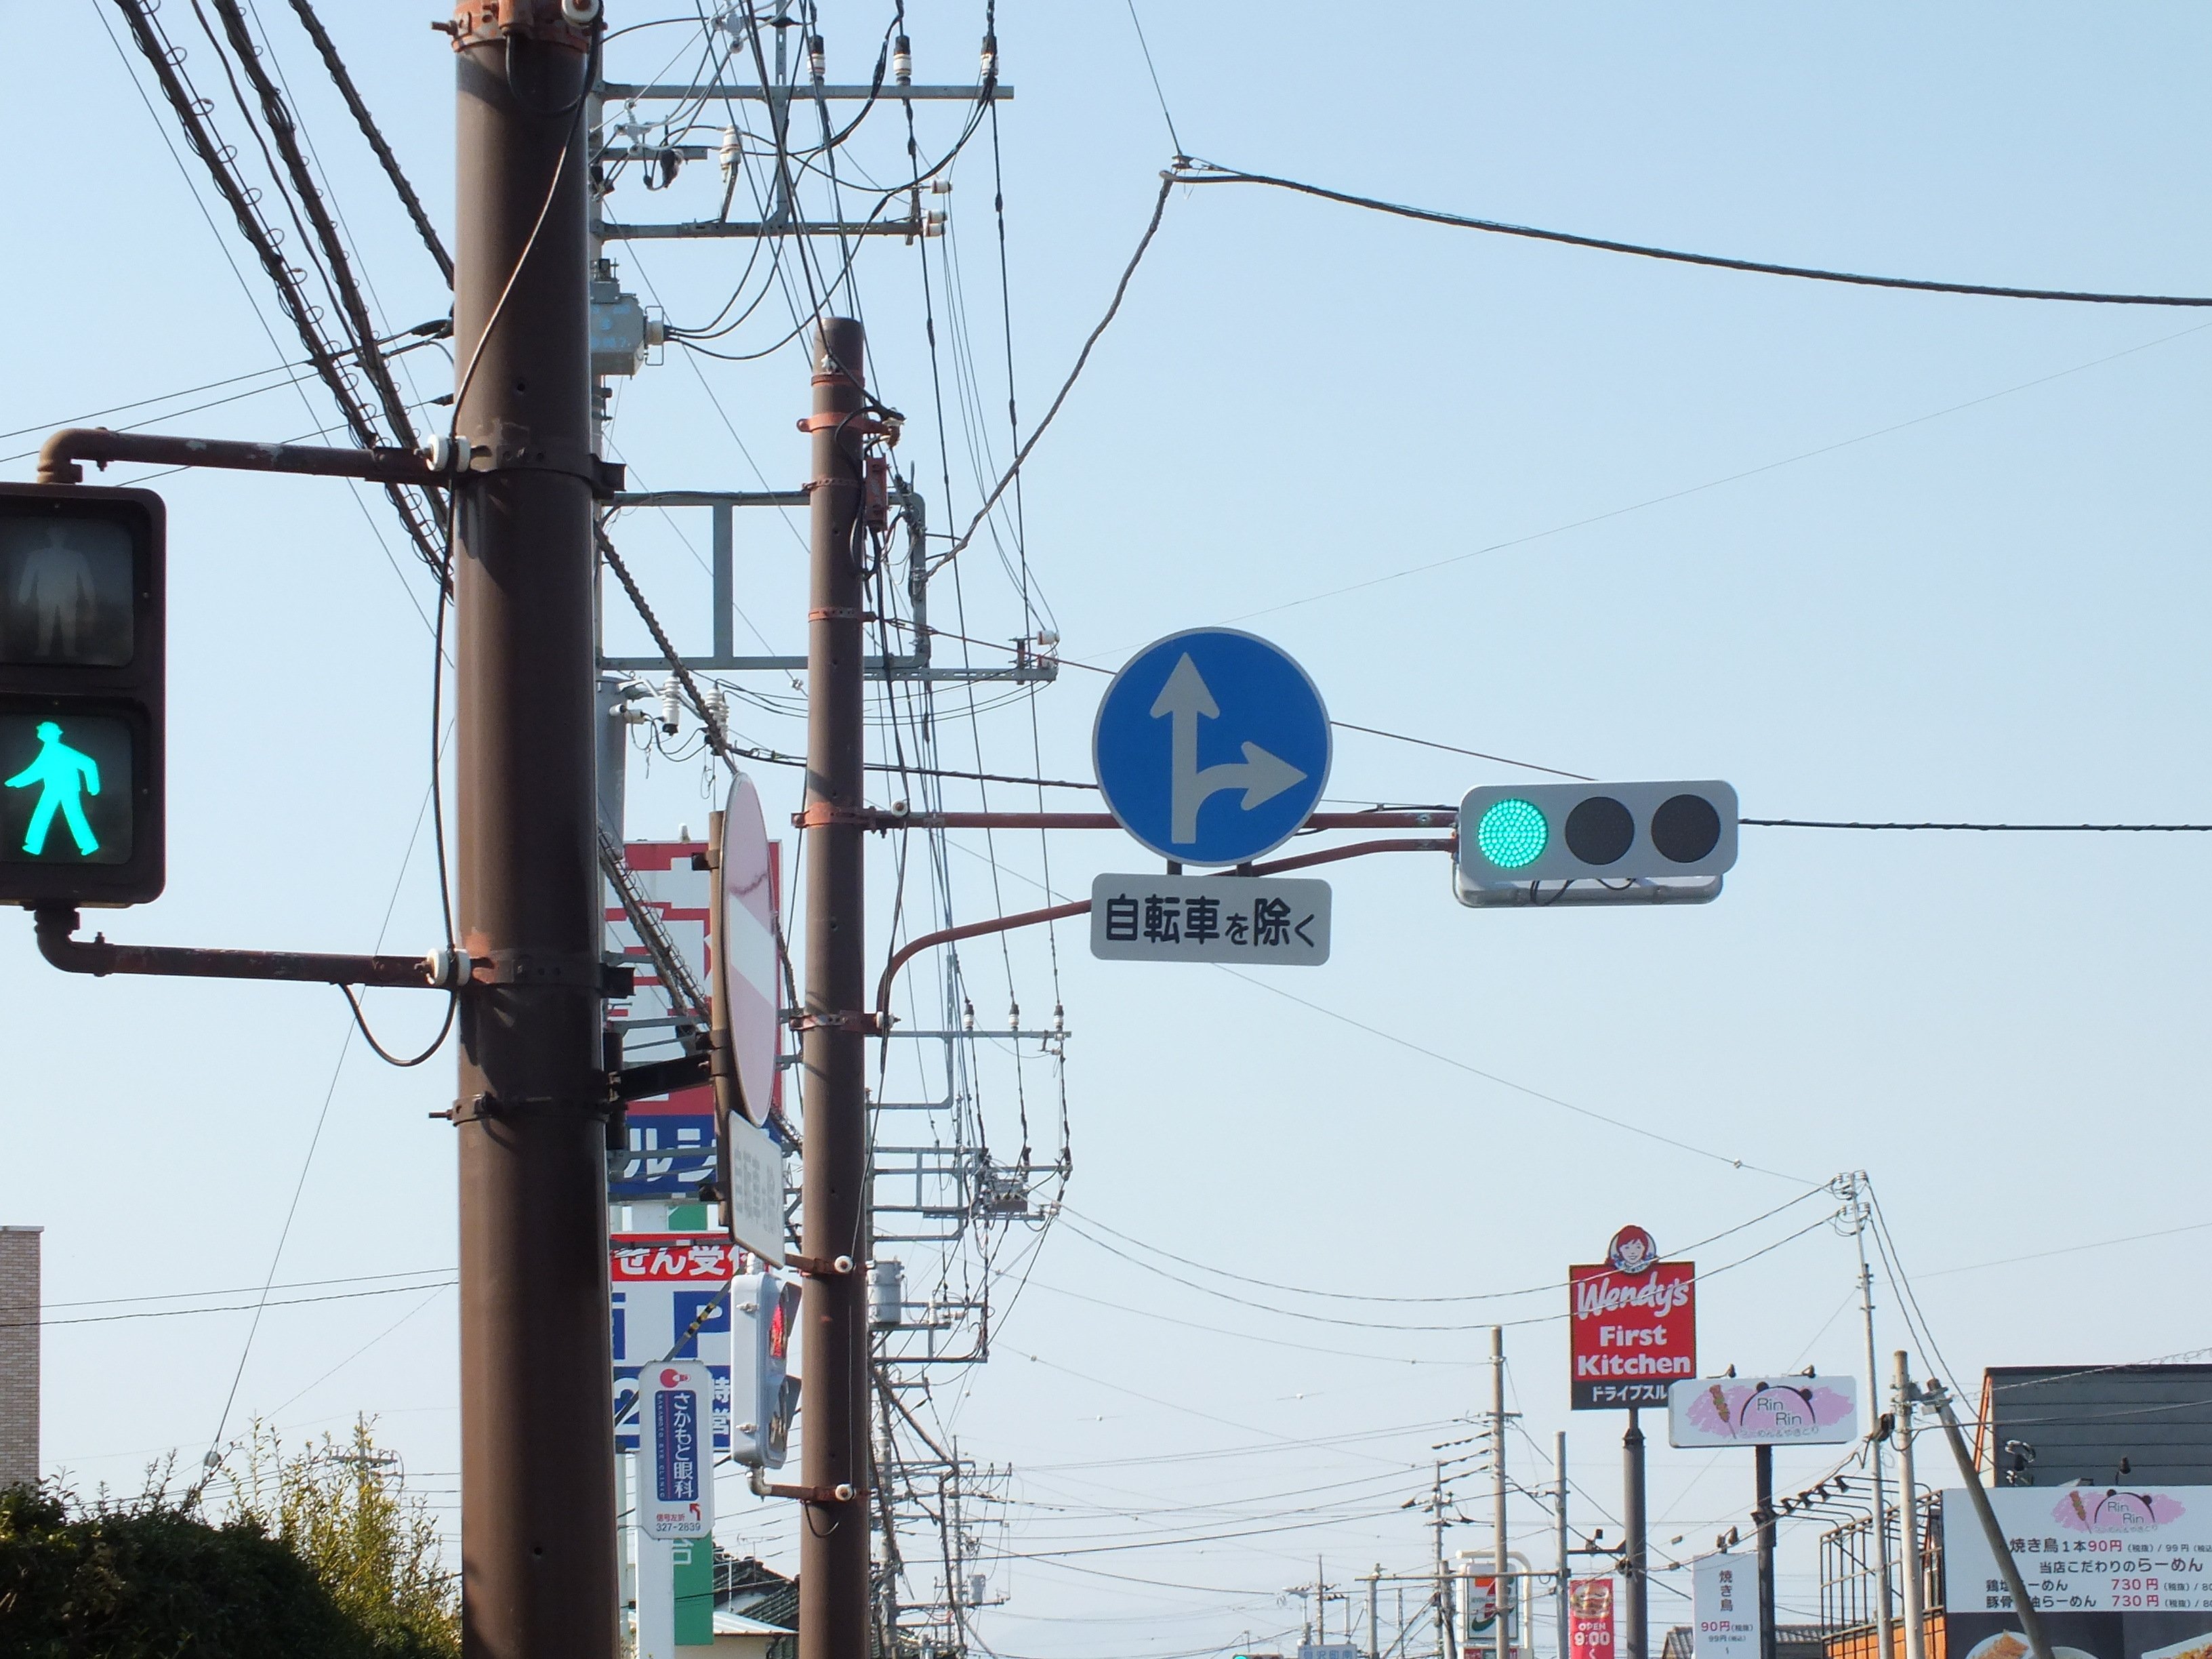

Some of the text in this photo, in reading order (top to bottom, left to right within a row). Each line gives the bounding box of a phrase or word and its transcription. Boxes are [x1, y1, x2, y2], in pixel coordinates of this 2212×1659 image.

[1106, 894, 1315, 947] 自転車を除く
[1577, 1271, 1689, 1321] Wendy's
[1600, 1325, 1668, 1347] First
[1578, 1353, 1691, 1376] Kitchen
[1758, 1397, 1784, 1411] Rin
[1776, 1412, 1802, 1425] Rin
[674, 1393, 694, 1499] さかもと眼科
[2108, 1501, 2129, 1512] Rin
[2123, 1513, 2144, 1524] Rin
[656, 1522, 701, 1532] 327-2839
[2040, 1558, 2203, 1574] 当店こだわりのらーめん
[1719, 1570, 1733, 1612] 焼き鳥
[1578, 1622, 1606, 1631] OPEN
[1574, 1631, 1610, 1646] 9:00
